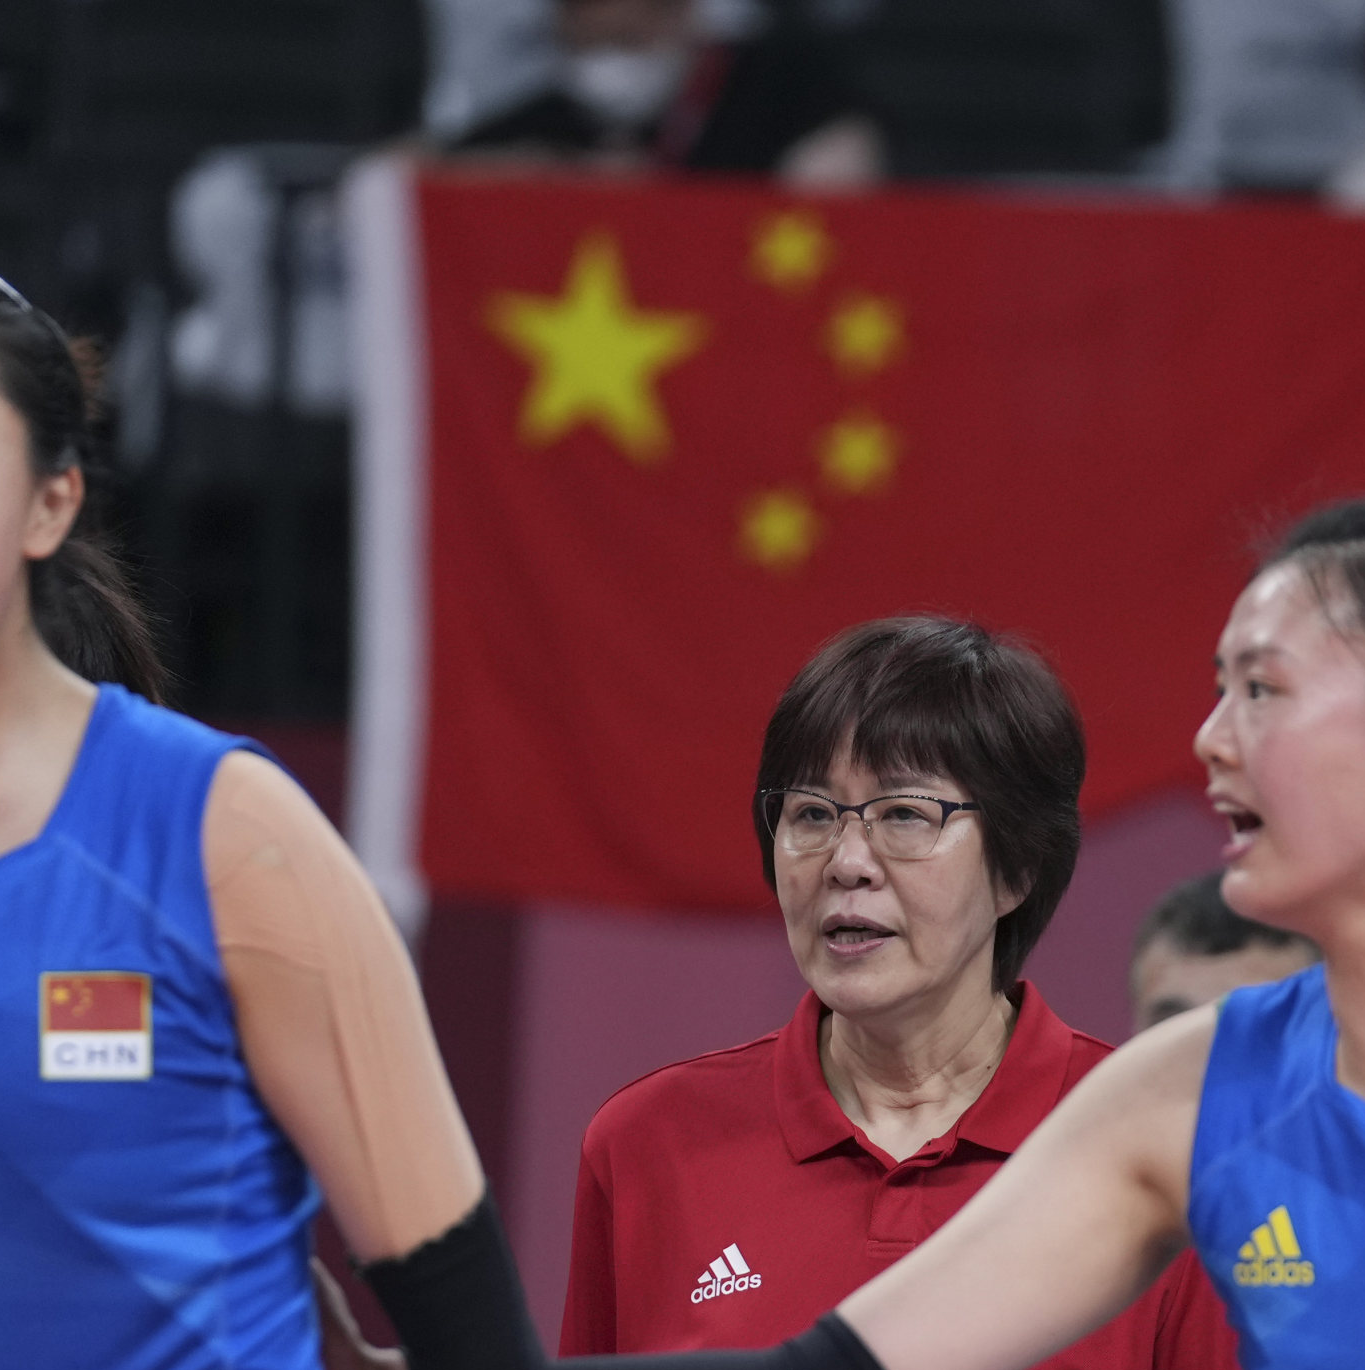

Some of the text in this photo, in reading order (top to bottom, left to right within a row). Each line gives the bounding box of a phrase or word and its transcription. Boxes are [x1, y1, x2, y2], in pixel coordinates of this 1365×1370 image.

[54, 1041, 138, 1067] CHN
[1233, 1258, 1315, 1287] adidas
[690, 1273, 762, 1304] adidas
